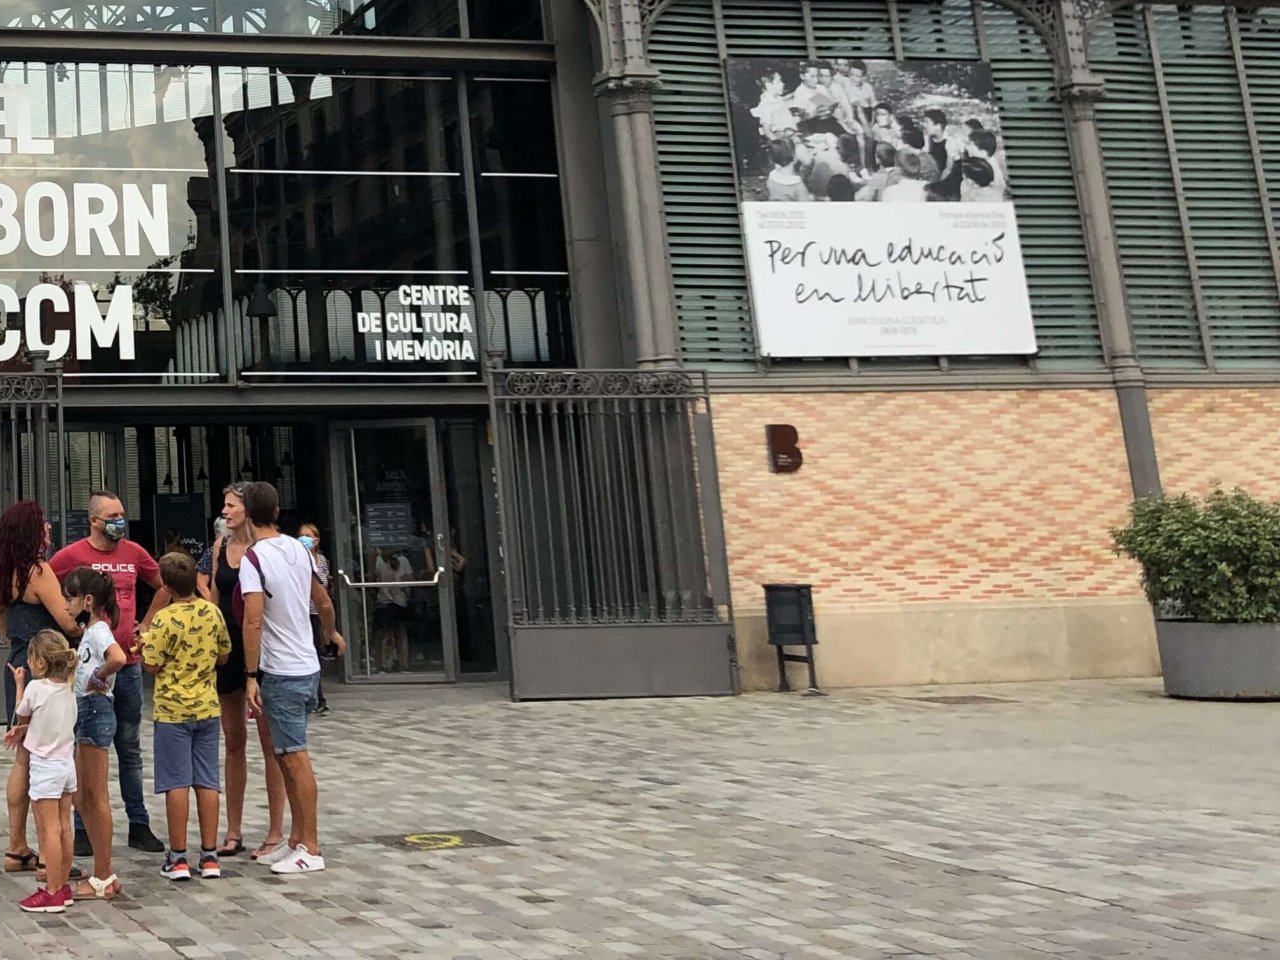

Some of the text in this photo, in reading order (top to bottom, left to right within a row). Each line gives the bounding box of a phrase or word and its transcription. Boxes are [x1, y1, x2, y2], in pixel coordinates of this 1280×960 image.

[765, 232, 1006, 272] Per una educació
[398, 285, 471, 306] CENTRE
[795, 271, 989, 304] en llibertat
[357, 312, 473, 333] DE CULTURA
[375, 337, 476, 361] I MEMÒRIA
[91, 563, 136, 573] POLICE
